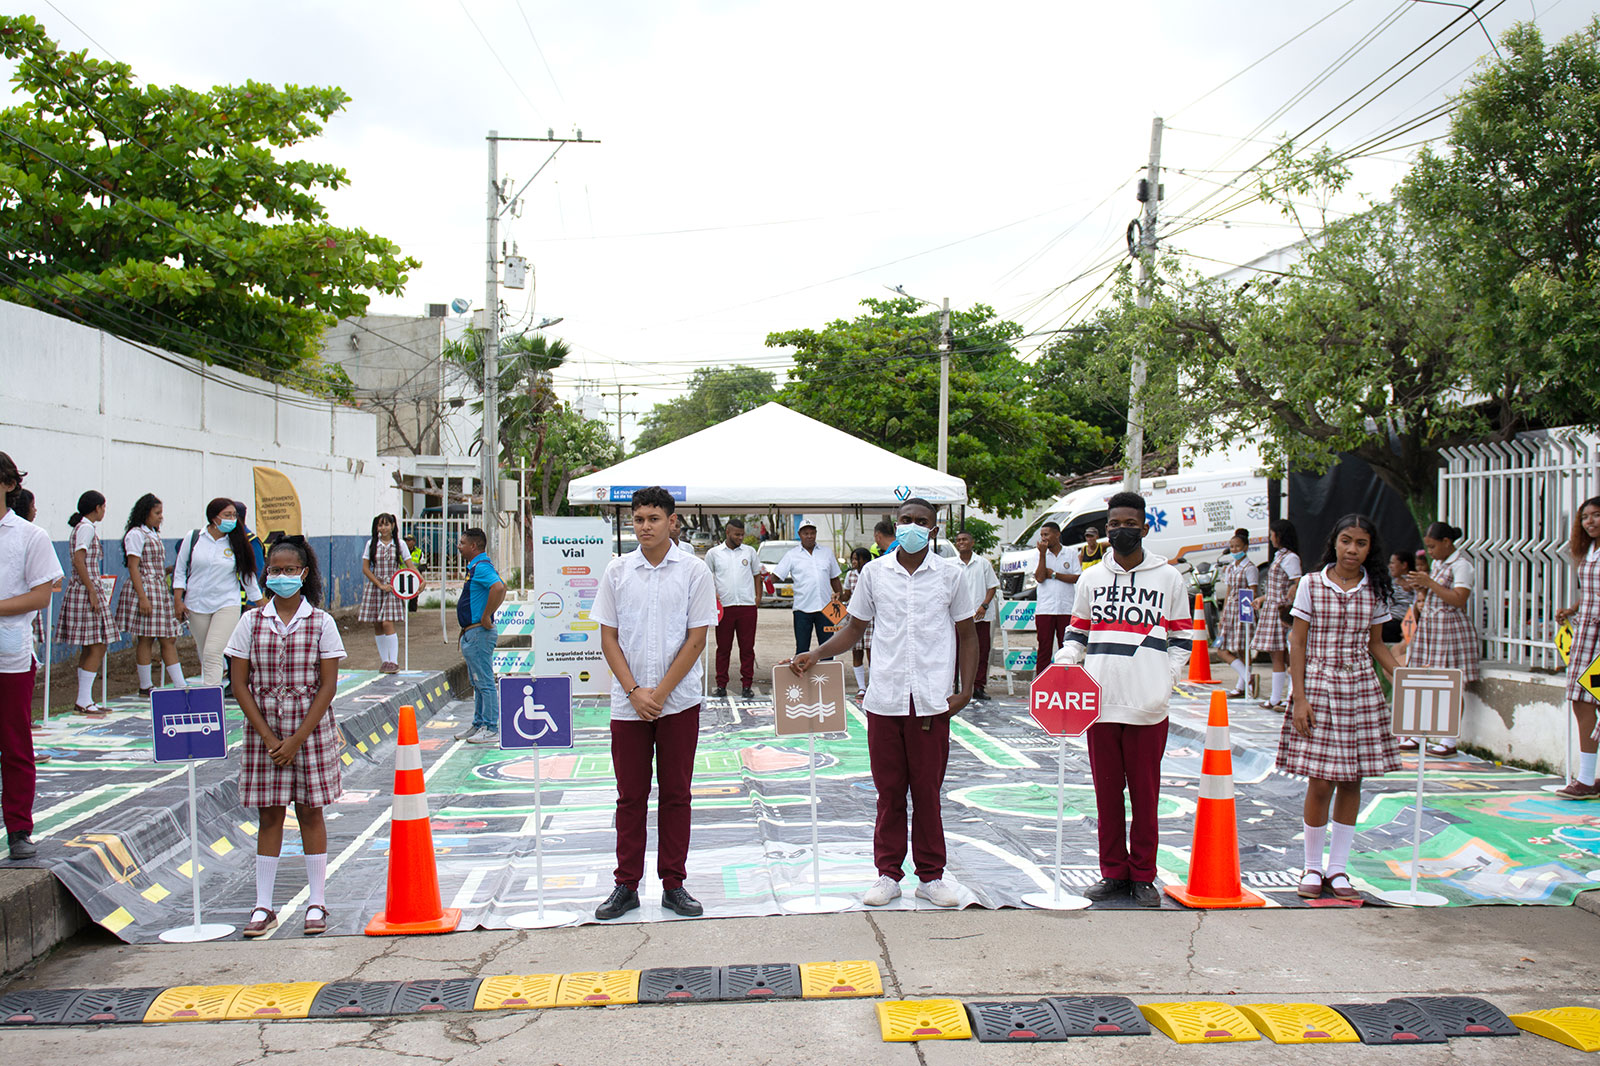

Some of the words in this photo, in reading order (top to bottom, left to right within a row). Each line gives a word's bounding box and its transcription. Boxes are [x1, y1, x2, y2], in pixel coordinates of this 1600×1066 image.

[1203, 505, 1233, 513] COBERTURA
[1204, 500, 1230, 508] CONVENIO
[542, 535, 604, 544] Educación
[562, 548, 585, 558] Vial
[1093, 586, 1164, 608] PERMI
[1091, 604, 1161, 628] SSION
[1035, 691, 1096, 710] PARE
